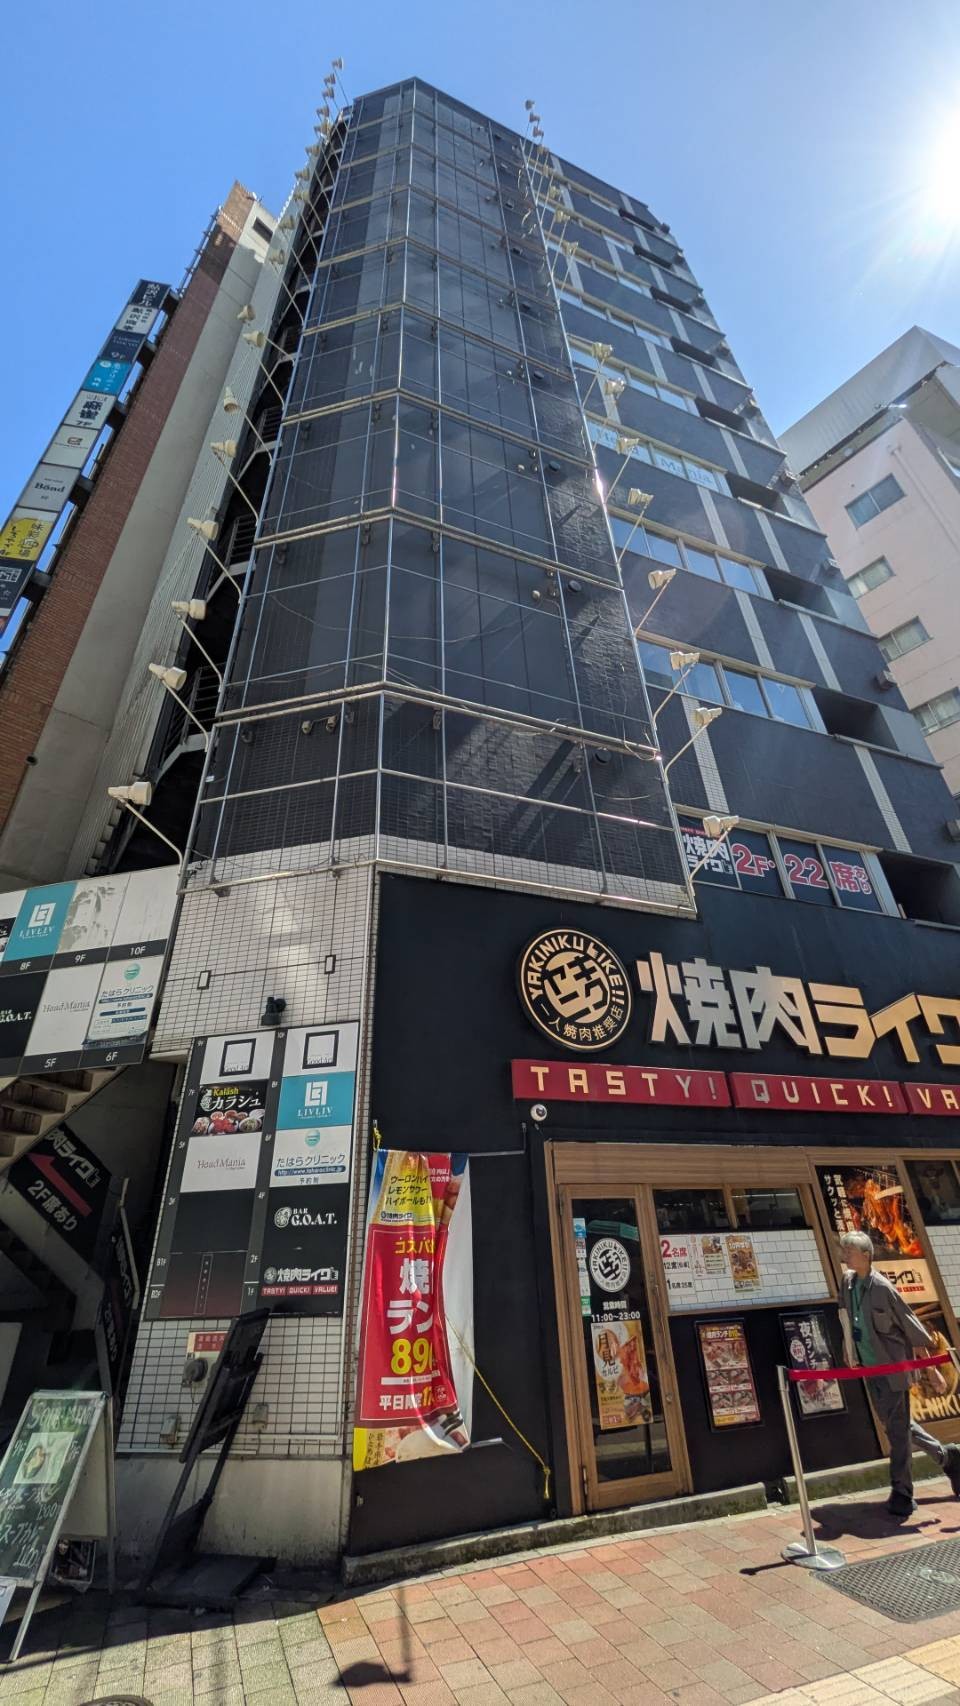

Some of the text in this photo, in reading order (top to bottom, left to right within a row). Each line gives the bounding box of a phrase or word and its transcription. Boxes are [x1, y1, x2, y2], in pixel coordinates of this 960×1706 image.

[130, 945, 146, 956] 10F
[75, 954, 87, 963] 9F
[20, 961, 31, 971] 8F
[106, 1051, 118, 1062] 6F
[44, 1058, 57, 1068] 5F
[529, 1066, 718, 1101] TASTY!
[750, 1079, 894, 1108] QUICK!
[212, 1095, 262, 1112] カラシュ
[297, 1107, 334, 1117] LIVLIV
[178, 1141, 186, 1149] 5F
[276, 1154, 346, 1168] たはらクリニック
[258, 1191, 265, 1200] 4F
[388, 1186, 428, 1195] レモンサワー
[28, 1179, 79, 1232] 2F席あり
[291, 1212, 338, 1226] G.O.A.T.
[156, 1254, 259, 1267] B1F 2F
[277, 1267, 332, 1283] 焼肉ライク
[263, 1284, 337, 1295] TASTY! QUICK! VALUE!
